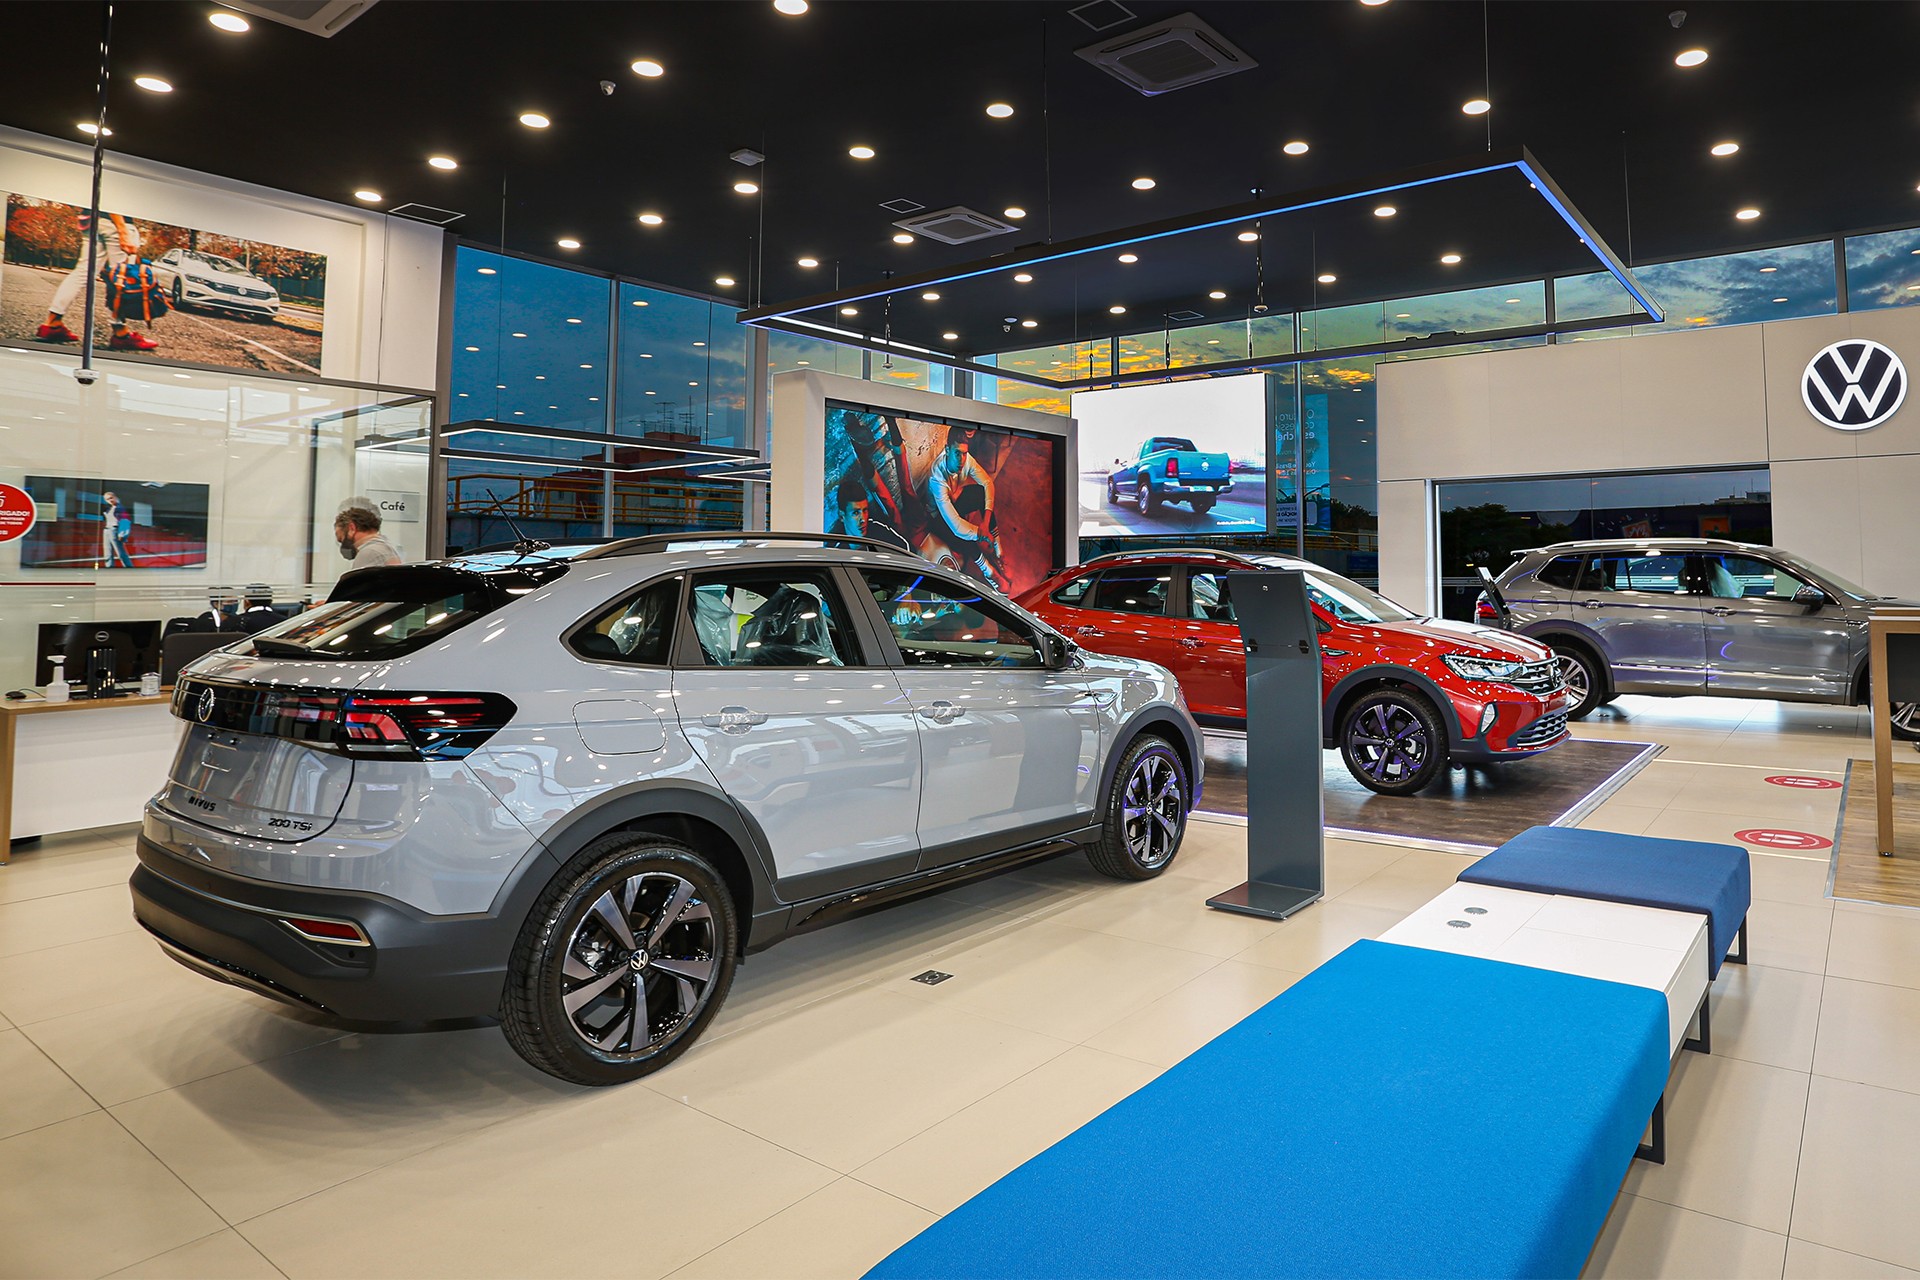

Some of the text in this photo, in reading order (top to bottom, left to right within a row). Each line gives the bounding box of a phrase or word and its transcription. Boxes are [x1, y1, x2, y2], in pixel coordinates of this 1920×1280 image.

[1802, 339, 1907, 430] VW
[380, 501, 405, 511] Café
[188, 796, 216, 812] NIVUS
[268, 817, 291, 828] 200
